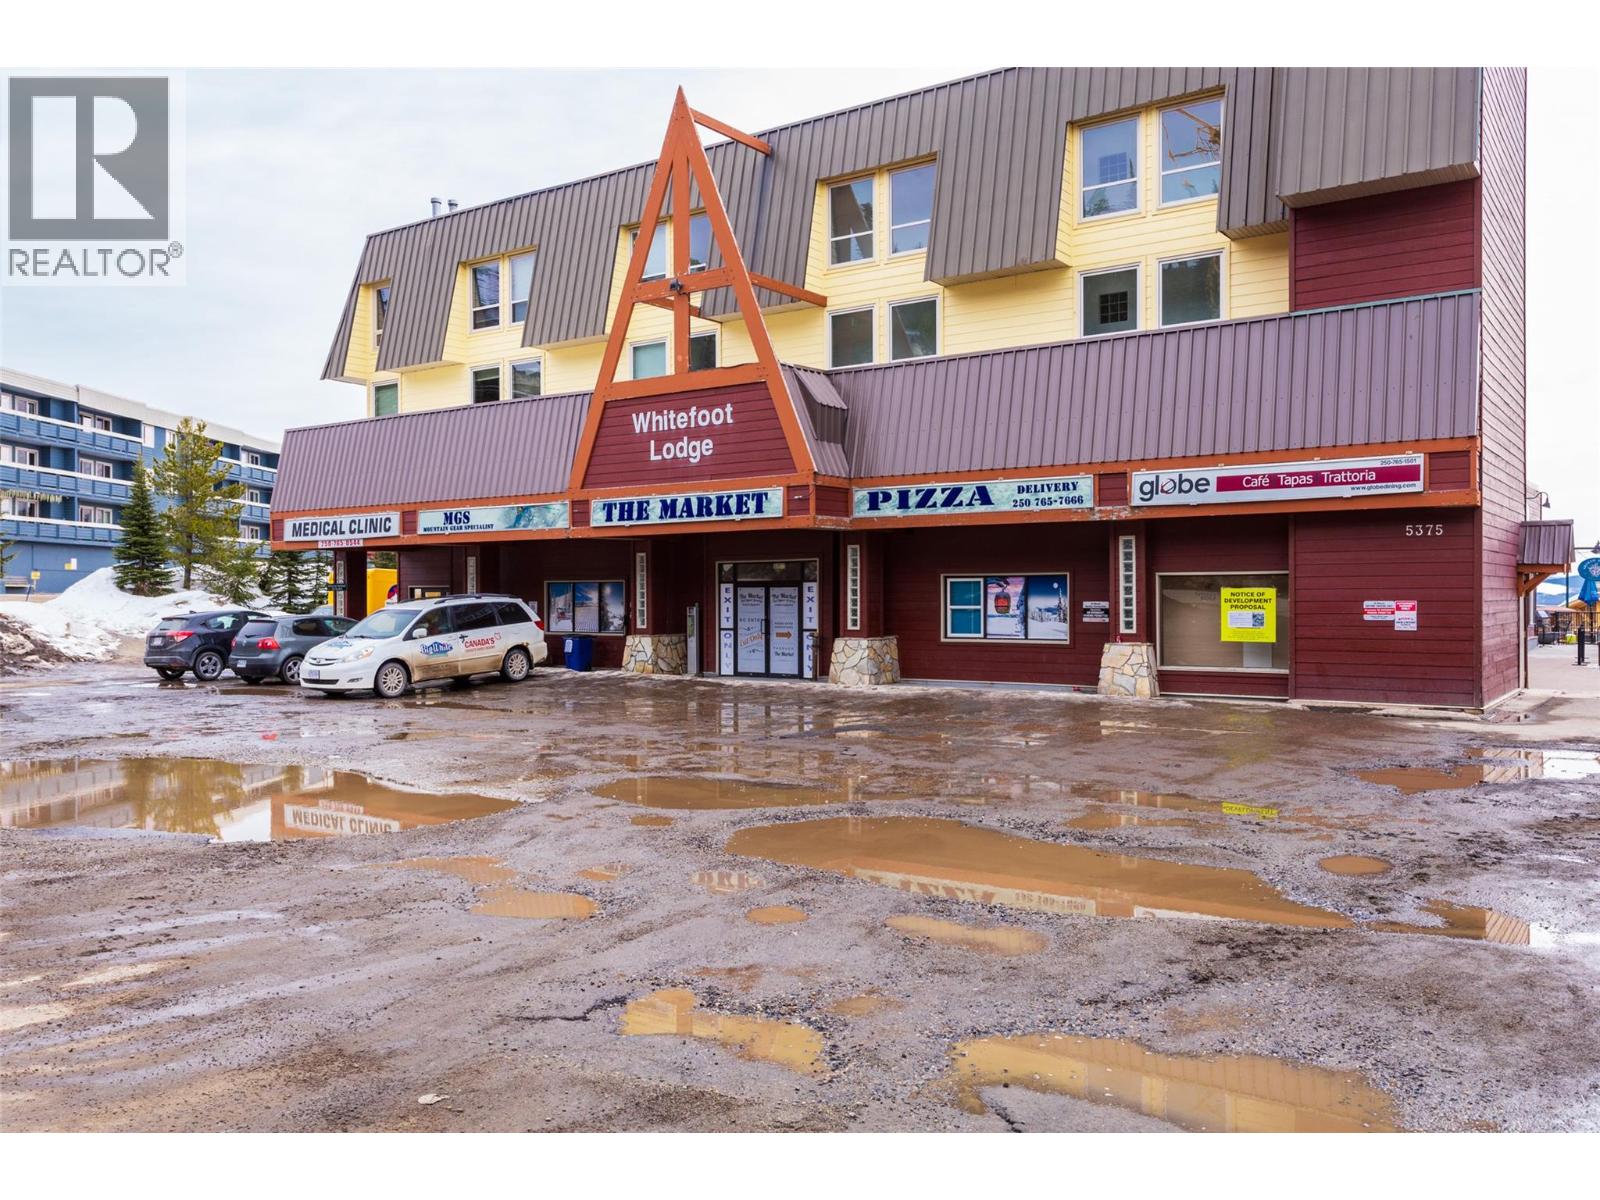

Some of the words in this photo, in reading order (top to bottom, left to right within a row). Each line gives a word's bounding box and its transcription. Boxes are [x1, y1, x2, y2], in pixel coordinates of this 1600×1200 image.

[632, 403, 733, 432] Whitefoot
[649, 436, 714, 463] Lodge
[1017, 481, 1079, 494] DELIVERY
[1139, 473, 1211, 502] globe
[1242, 474, 1270, 489] Café
[1278, 474, 1313, 489] Tapas
[1321, 469, 1376, 484] Trattoria
[1350, 482, 1417, 492] www.globedining.com
[602, 500, 650, 523] THE
[659, 491, 769, 520] MARKET
[866, 485, 995, 512] PIZZA
[1012, 498, 1031, 508] 250
[1035, 495, 1084, 507] 765-7666
[292, 520, 346, 537] MEDICAL
[349, 517, 392, 535] CLINIC
[443, 511, 471, 525] MGS
[1405, 524, 1443, 536] 5375
[724, 587, 732, 623] EXIT
[806, 586, 814, 623] EXIT
[464, 637, 495, 649] CANADA'S
